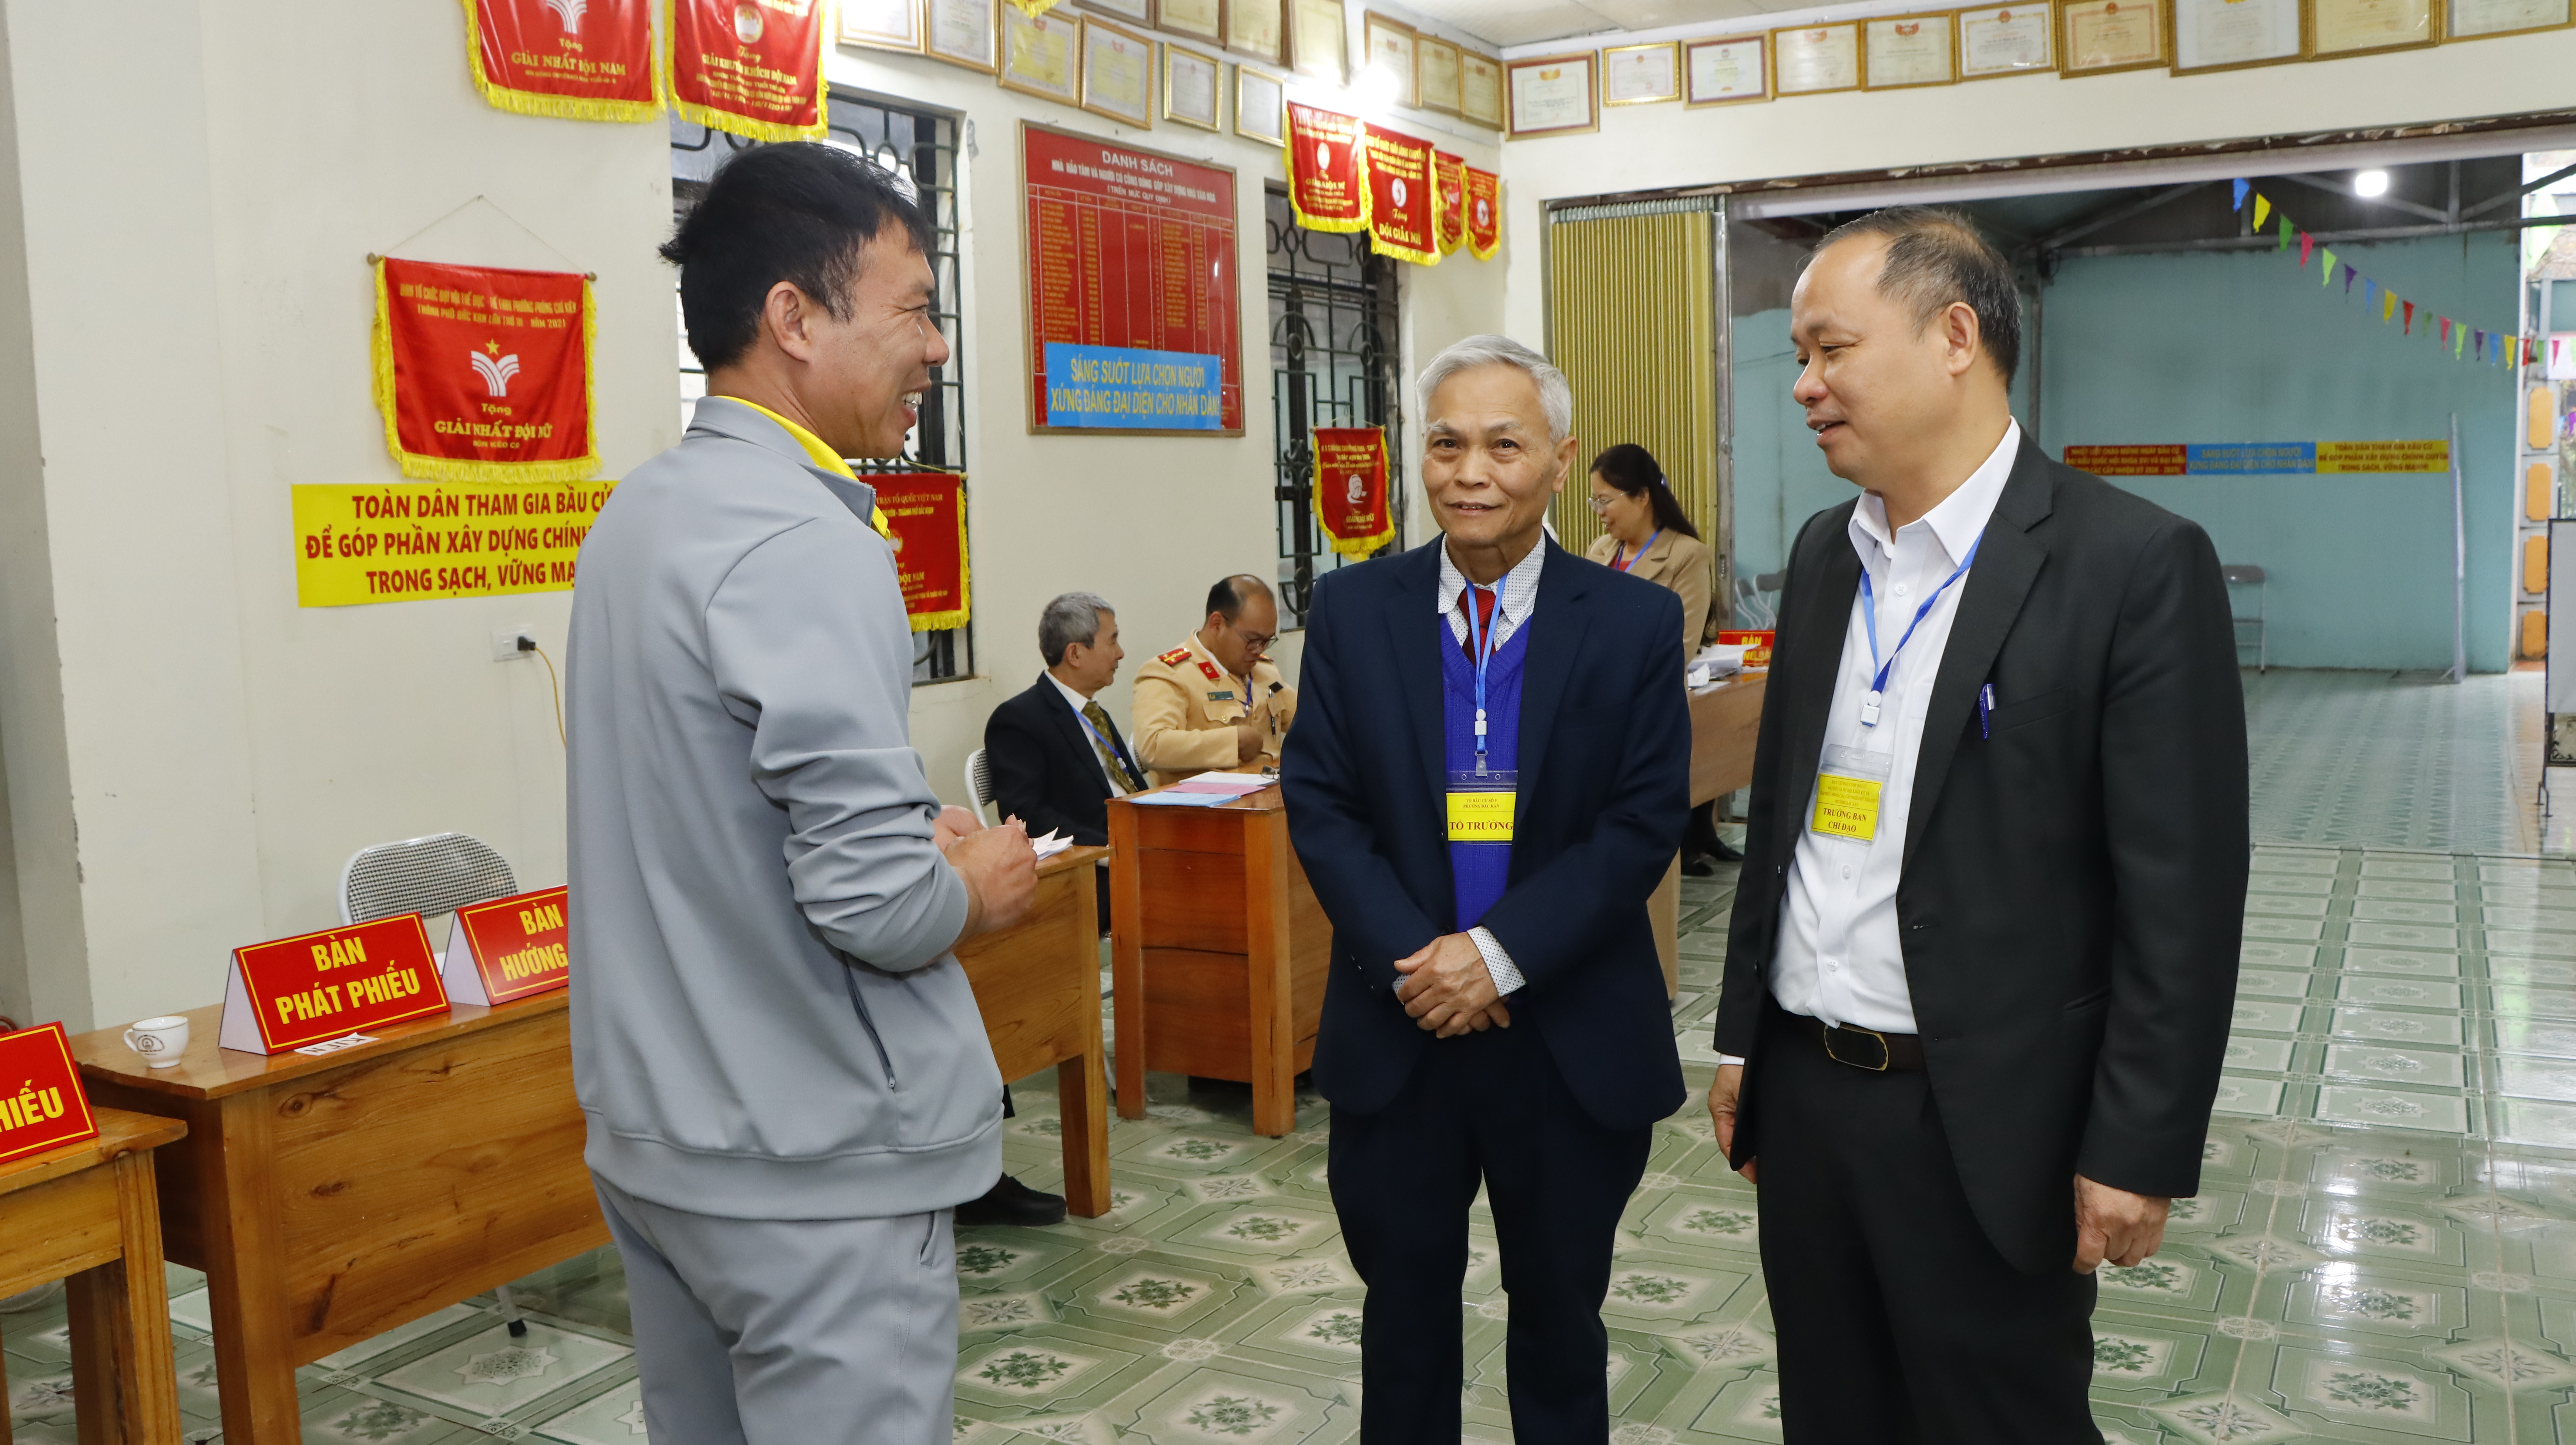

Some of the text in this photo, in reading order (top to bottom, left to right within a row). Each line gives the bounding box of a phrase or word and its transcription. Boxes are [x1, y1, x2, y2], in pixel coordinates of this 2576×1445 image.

[1102, 150, 1173, 177] DANH SÁCH
[1071, 353, 1205, 391] SÁNG SUỐT LỰA CHỌN NGƯỜI
[1051, 383, 1082, 412] XỨNG
[1083, 385, 1111, 413] ĐÁNG
[1113, 390, 1130, 419] ĐẠI
[1133, 390, 1154, 419] DIỆN
[1156, 392, 1174, 415] CHO
[1176, 389, 1198, 416] NHÂN
[434, 418, 471, 435] GIẢI
[473, 419, 512, 437] NHẤT
[515, 423, 536, 440] ĐỘI
[352, 489, 410, 518] TOÀN
[417, 488, 459, 517] DÂN
[465, 493, 517, 517] THAM
[523, 494, 551, 514] GIA
[556, 484, 586, 513] BẦU
[305, 524, 333, 559] ĐỂ
[339, 527, 378, 557] GÓP
[384, 523, 440, 555] PHẦN
[446, 524, 482, 553] XÂY
[489, 526, 538, 556] DỰNG
[366, 568, 432, 594] TRONG
[438, 566, 491, 595] SẠCH,
[497, 560, 546, 586] VỮNG
[1466, 819, 1513, 831] TRƯỞNG
[1824, 808, 1867, 822] TRƯỞNG BAN
[1828, 821, 1857, 834] CHỈ ĐẠO
[519, 902, 564, 935] BÀN
[311, 935, 367, 972] BÀN
[499, 942, 568, 982] HƯỚNG
[275, 959, 420, 1025] PHÁT PHIẾU
